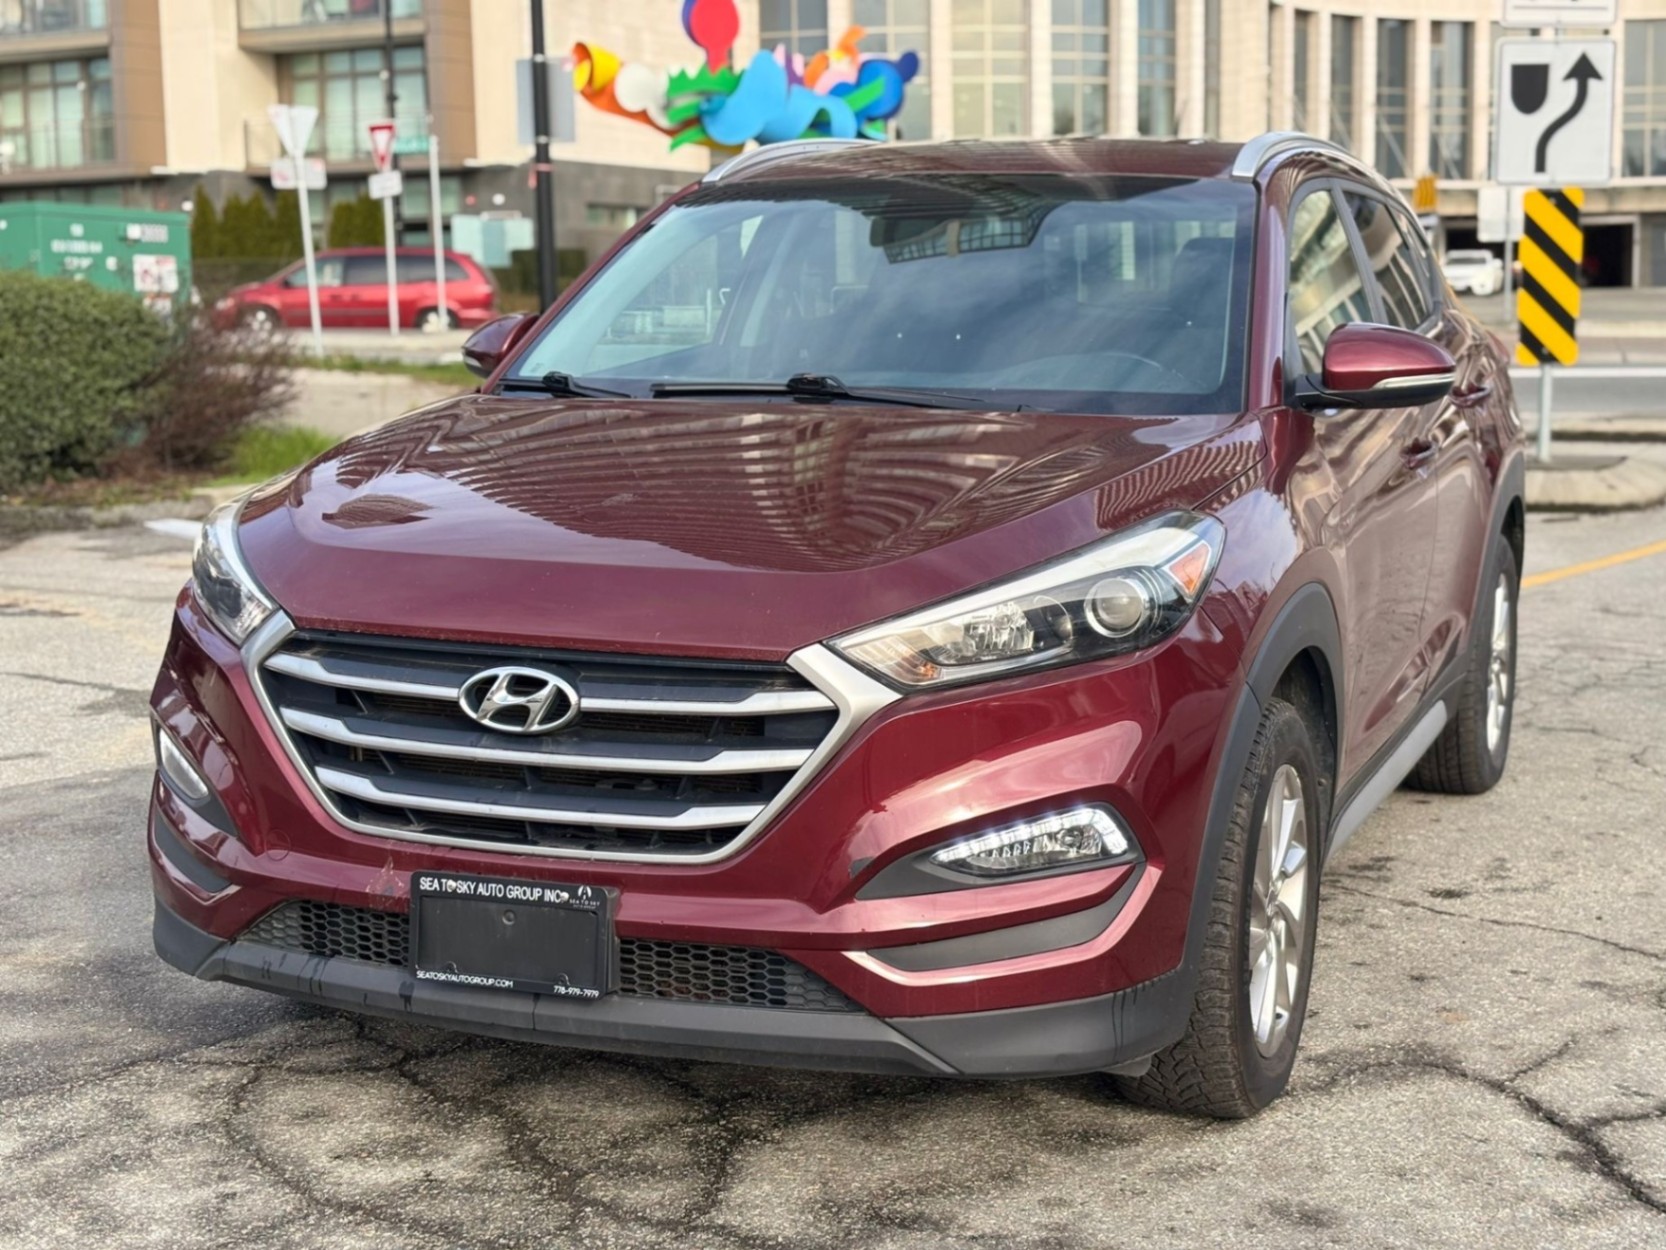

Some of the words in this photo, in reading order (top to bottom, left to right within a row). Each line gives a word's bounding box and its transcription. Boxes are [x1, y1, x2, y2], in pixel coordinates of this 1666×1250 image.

[419, 876, 440, 891] SEA
[456, 880, 476, 894] SKY
[476, 882, 505, 898] AUTO
[506, 885, 543, 901] GROUP
[416, 970, 514, 988] SEATOSKYAUTOGROUP.COM
[553, 984, 600, 998] 778-979-7979
